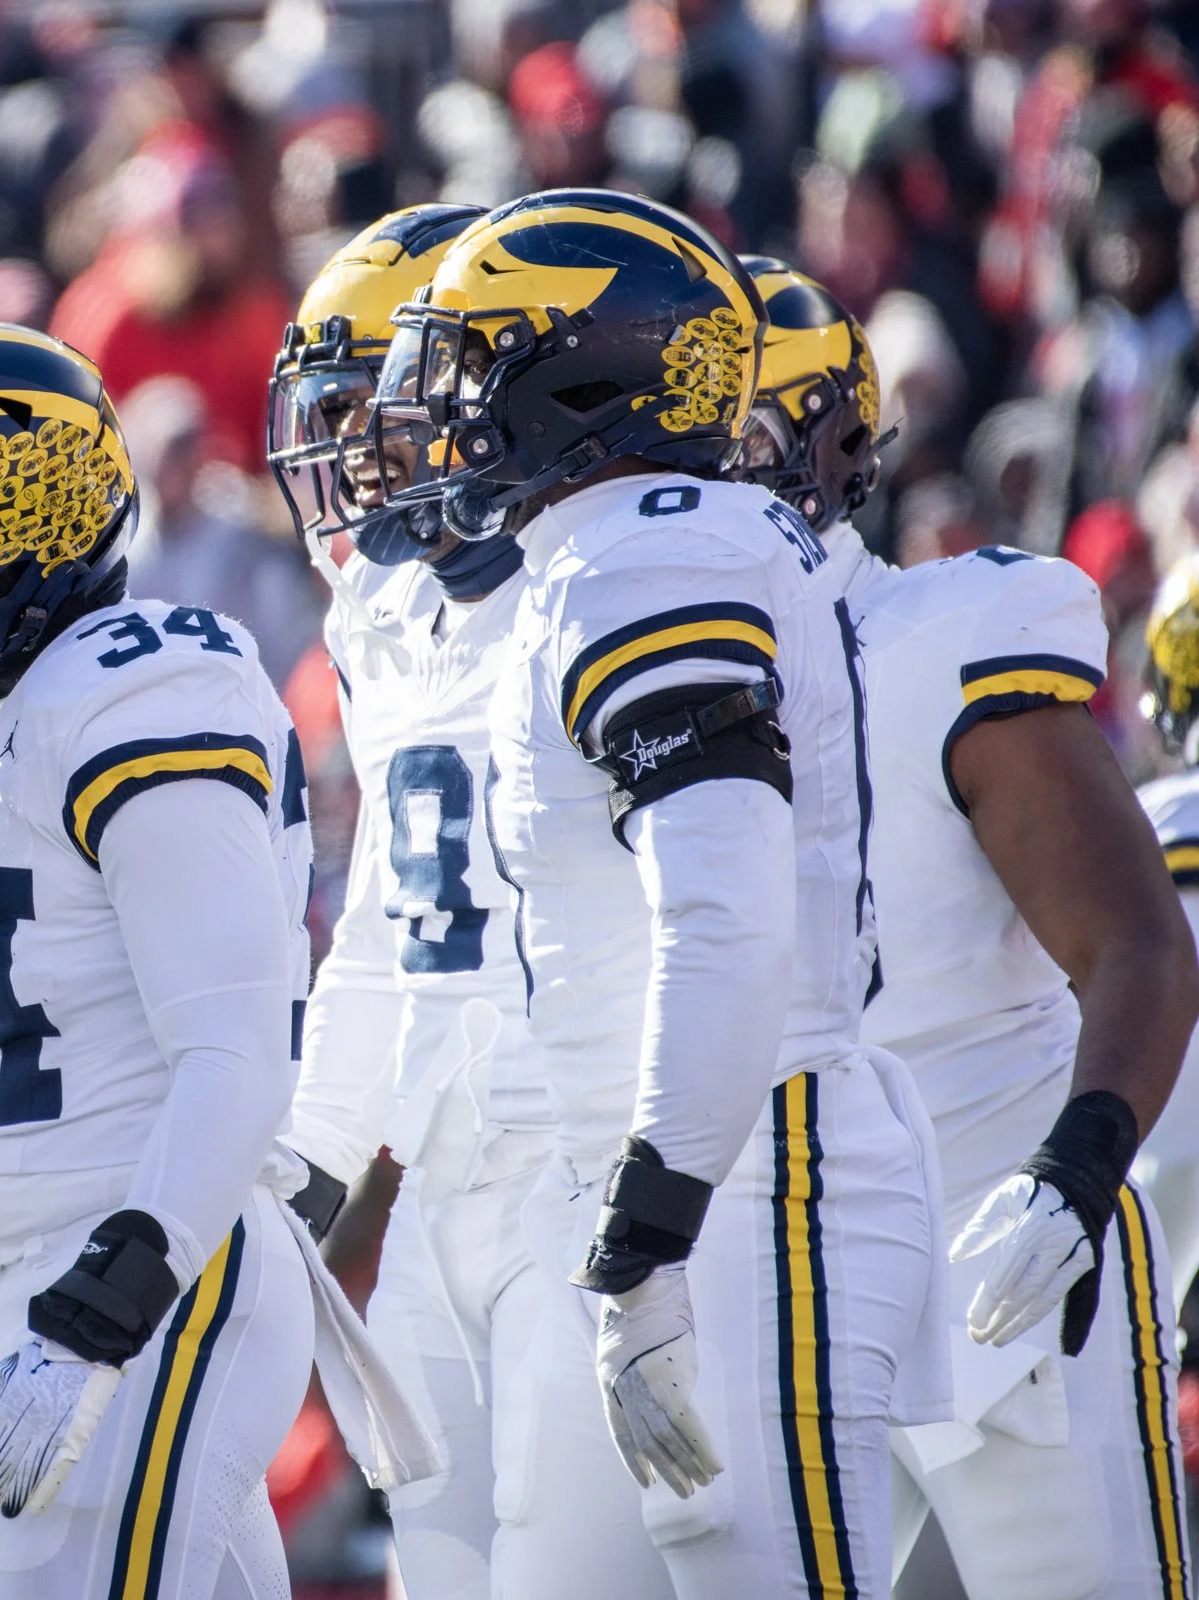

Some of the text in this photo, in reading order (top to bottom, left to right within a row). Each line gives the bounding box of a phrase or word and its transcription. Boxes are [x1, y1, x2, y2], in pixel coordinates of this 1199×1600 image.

[30, 529, 53, 547] TED
[72, 534, 92, 553] TED
[76, 605, 244, 669] 34
[636, 733, 690, 763] Douglas
